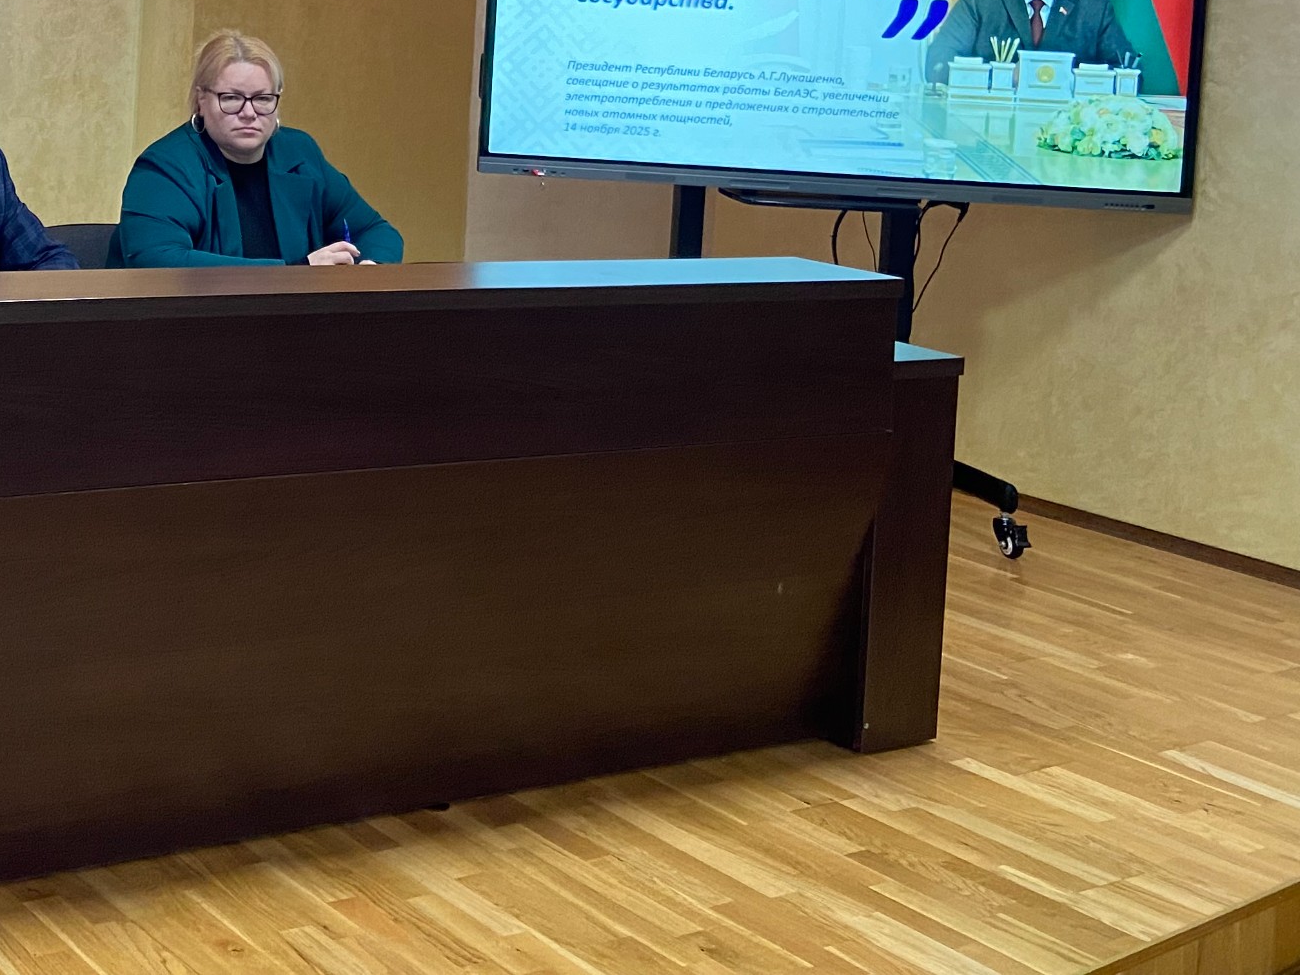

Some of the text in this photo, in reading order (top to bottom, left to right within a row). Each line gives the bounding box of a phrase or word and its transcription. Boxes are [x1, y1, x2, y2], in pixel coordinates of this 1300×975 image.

[567, 60, 845, 86] Президент Республики Беларусь А.Г.Лукашенко,
[566, 77, 629, 88] совещание
[641, 82, 720, 94] результатах
[722, 85, 770, 96] работы
[774, 87, 818, 100] БелАЭС,
[822, 92, 890, 103] увеличении
[565, 93, 692, 107] электропотребления
[705, 100, 788, 113] предложениях
[802, 107, 899, 119] строительстве
[565, 108, 732, 127] новых атомных мощностей,
[564, 122, 577, 132] 14
[580, 124, 620, 135] ноября
[623, 125, 650, 136] 2025
